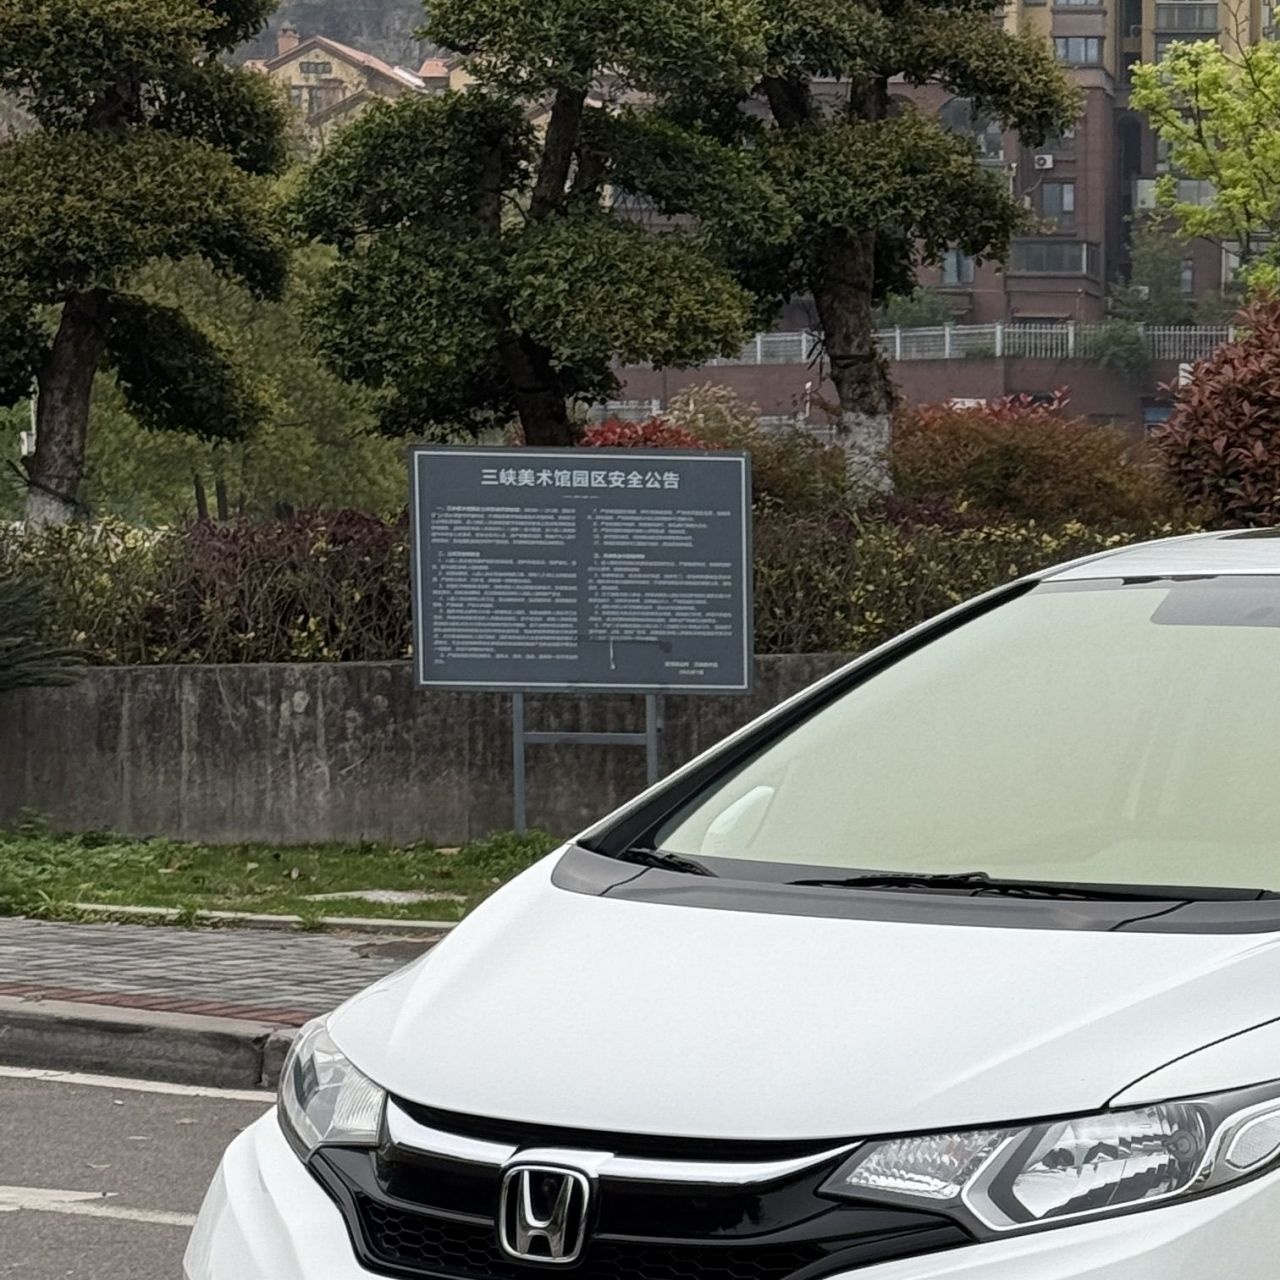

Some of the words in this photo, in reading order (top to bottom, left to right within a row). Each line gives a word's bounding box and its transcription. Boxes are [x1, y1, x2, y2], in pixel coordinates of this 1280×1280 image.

[481, 468, 680, 489] 三峡美术馆园区安全公告
